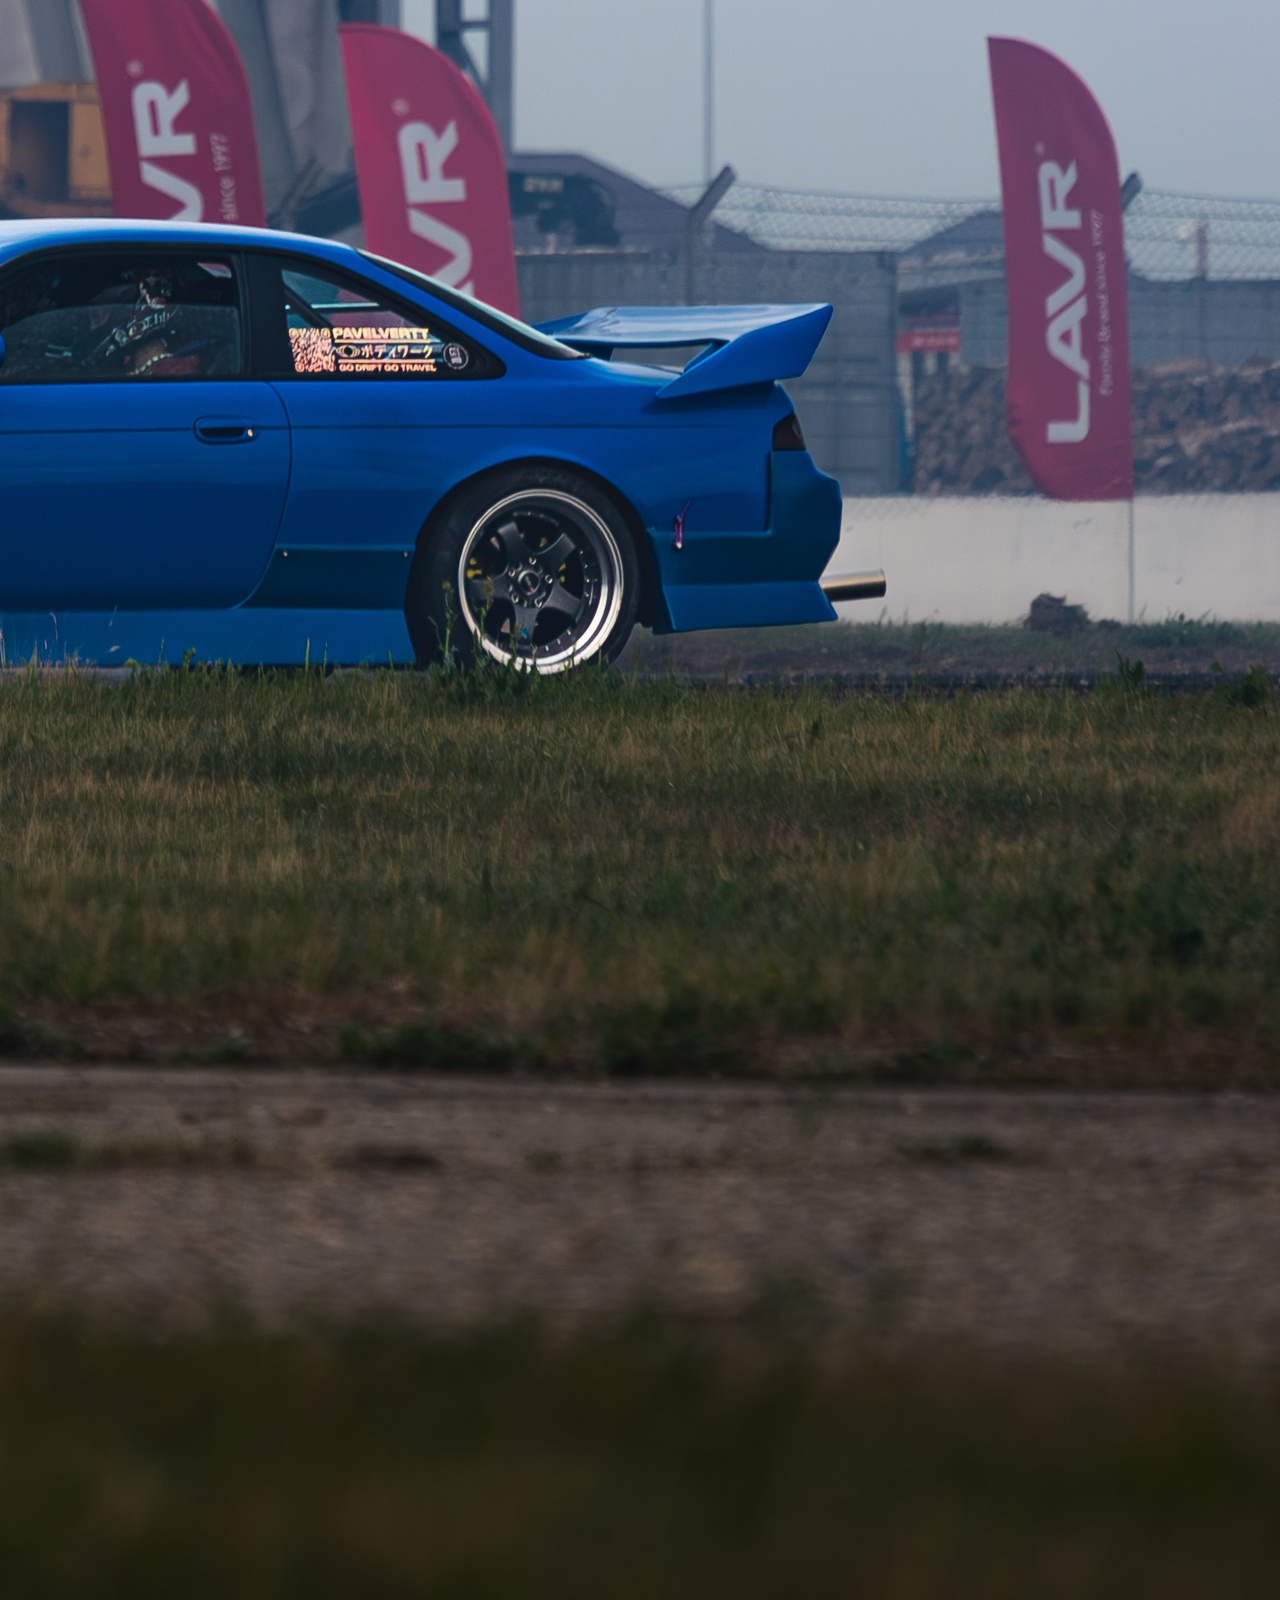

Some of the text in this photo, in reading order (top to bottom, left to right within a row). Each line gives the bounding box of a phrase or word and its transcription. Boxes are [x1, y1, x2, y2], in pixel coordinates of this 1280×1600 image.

[397, 118, 475, 299] VR
[338, 363, 437, 372] GO DRIFT GO TRAVEL
[1037, 158, 1091, 444] LAVR
